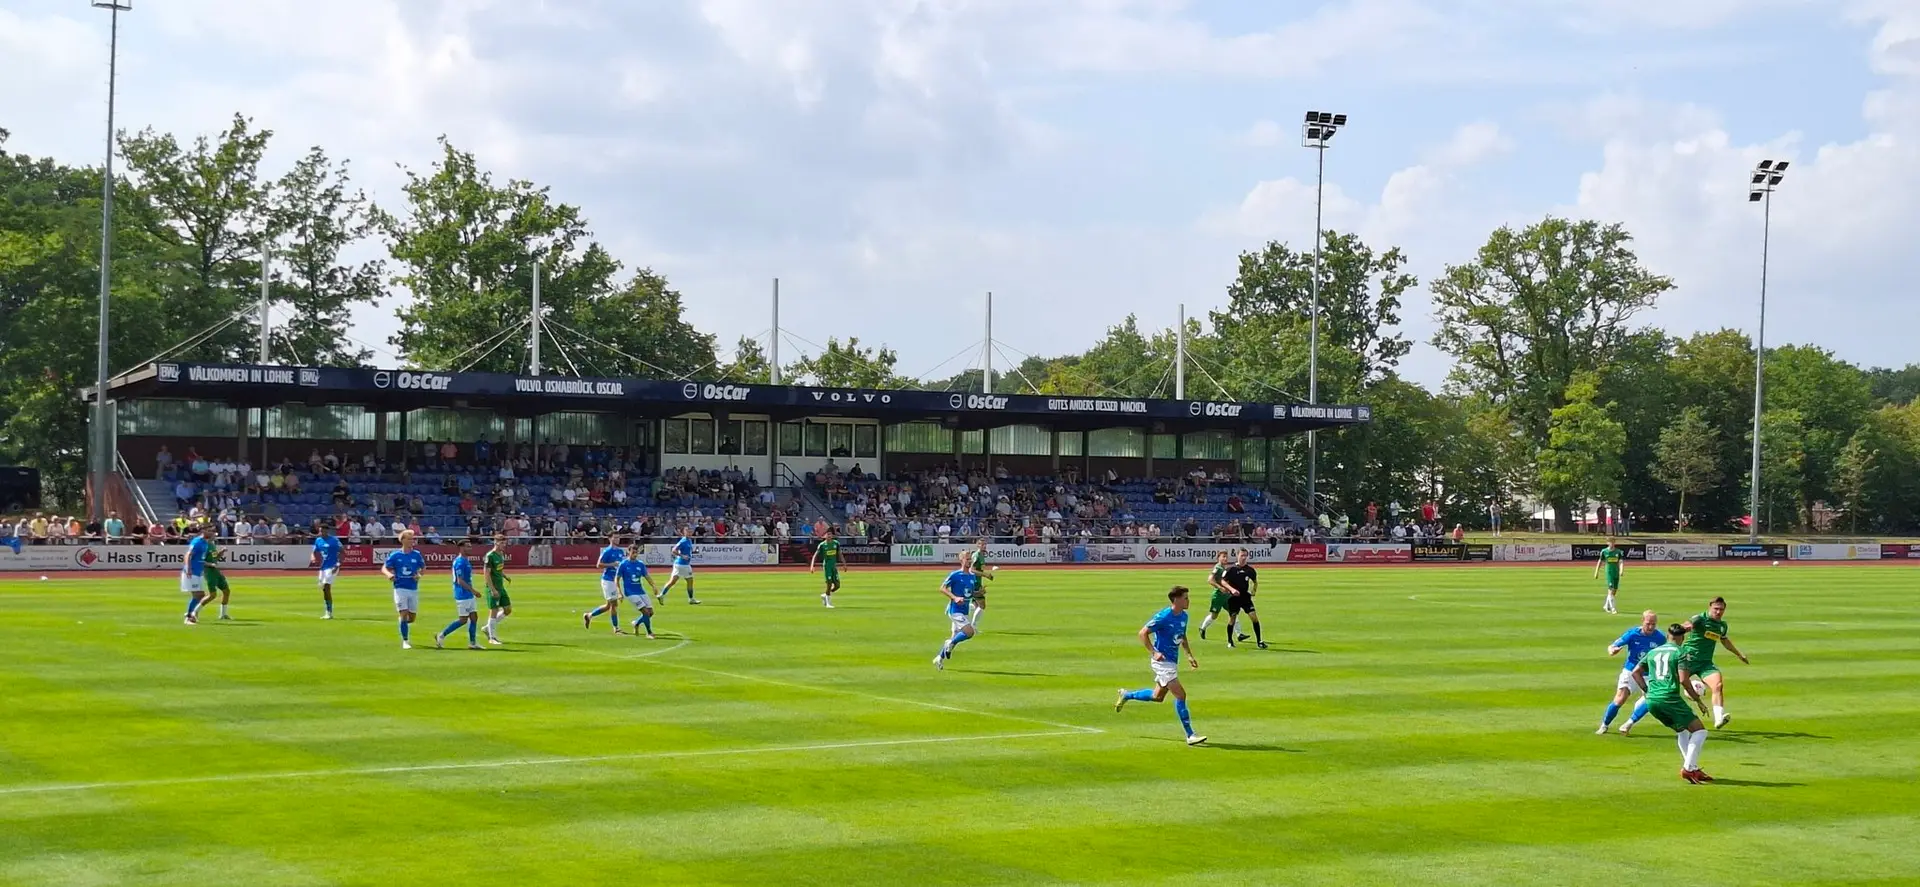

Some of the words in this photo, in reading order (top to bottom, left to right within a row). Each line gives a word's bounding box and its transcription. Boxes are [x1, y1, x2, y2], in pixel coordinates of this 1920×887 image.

[189, 366, 249, 382] VÄLKOMMEN
[251, 369, 262, 382] IN
[264, 370, 295, 384] LOHNE
[515, 379, 544, 392] VOLVO.
[545, 380, 595, 394] OSNABRÜCK.
[596, 382, 626, 395] OSCAR.
[812, 391, 892, 403] VOLVO
[1048, 399, 1068, 411] GUTES
[1069, 400, 1095, 411] ANDERS
[900, 545, 923, 556] LVM
[1164, 548, 1186, 558] Hass
[1230, 548, 1237, 557] &
[1647, 547, 1665, 556] EPS
[108, 551, 142, 563] Hass
[231, 550, 285, 565] Logistik
[1653, 652, 1671, 680] 11
